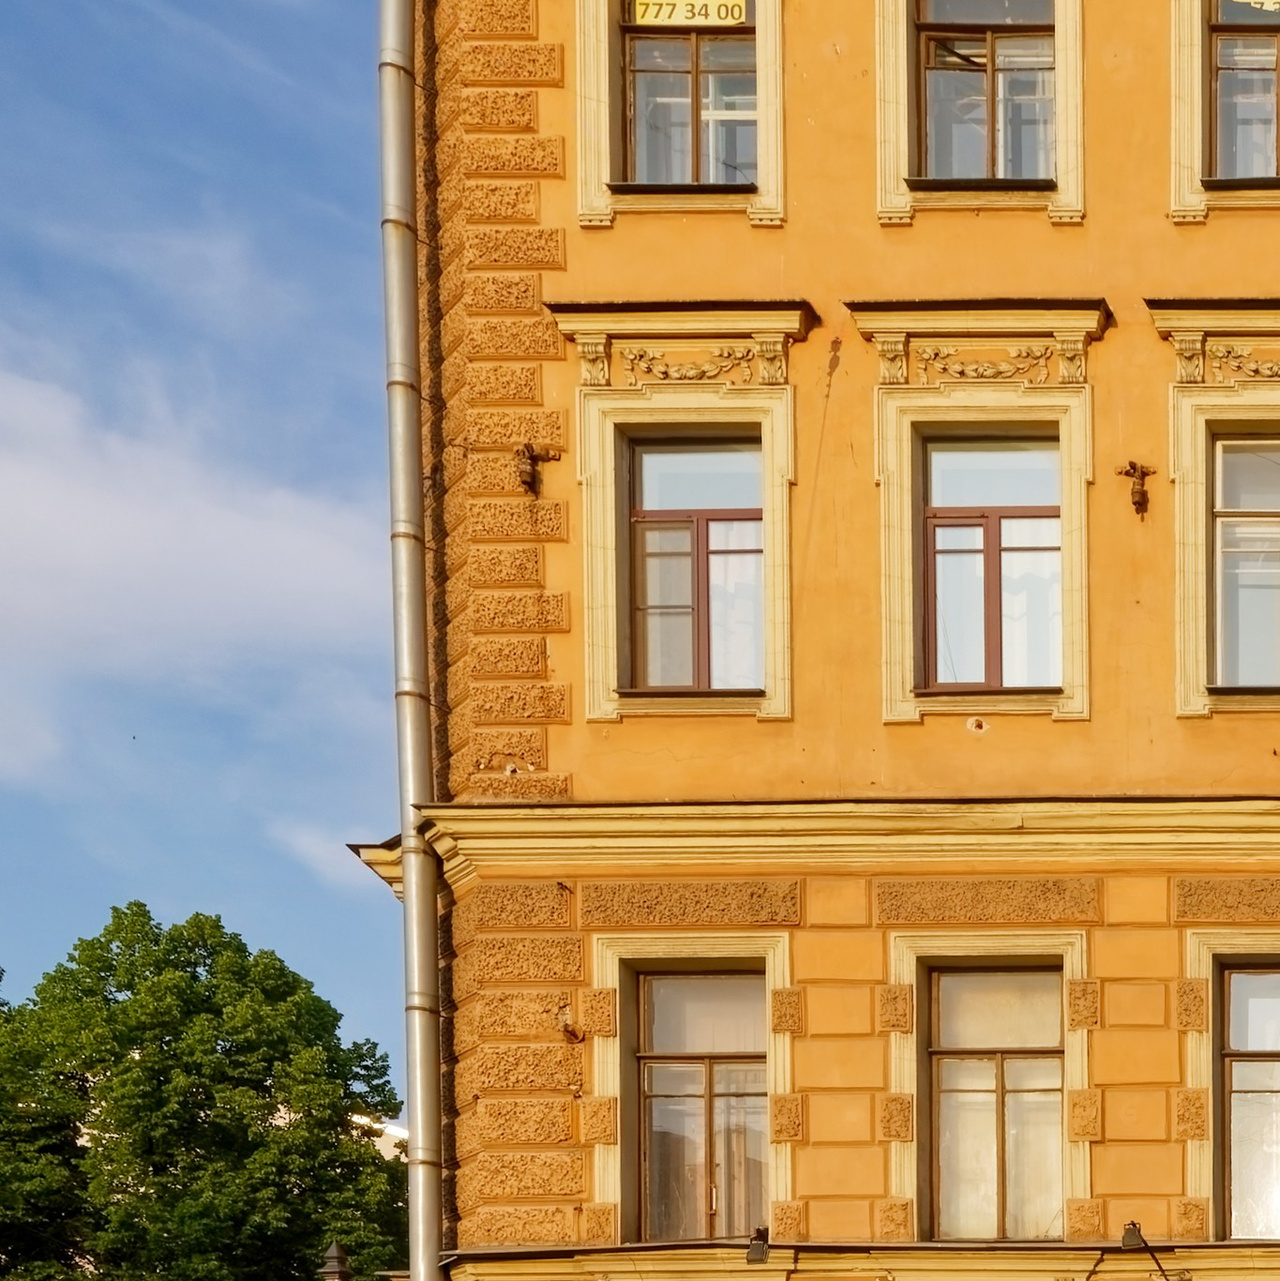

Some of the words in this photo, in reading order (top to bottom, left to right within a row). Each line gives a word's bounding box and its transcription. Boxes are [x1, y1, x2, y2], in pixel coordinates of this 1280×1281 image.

[638, 2, 677, 19] 777
[684, 3, 710, 20] 34
[716, 3, 743, 20] 00
